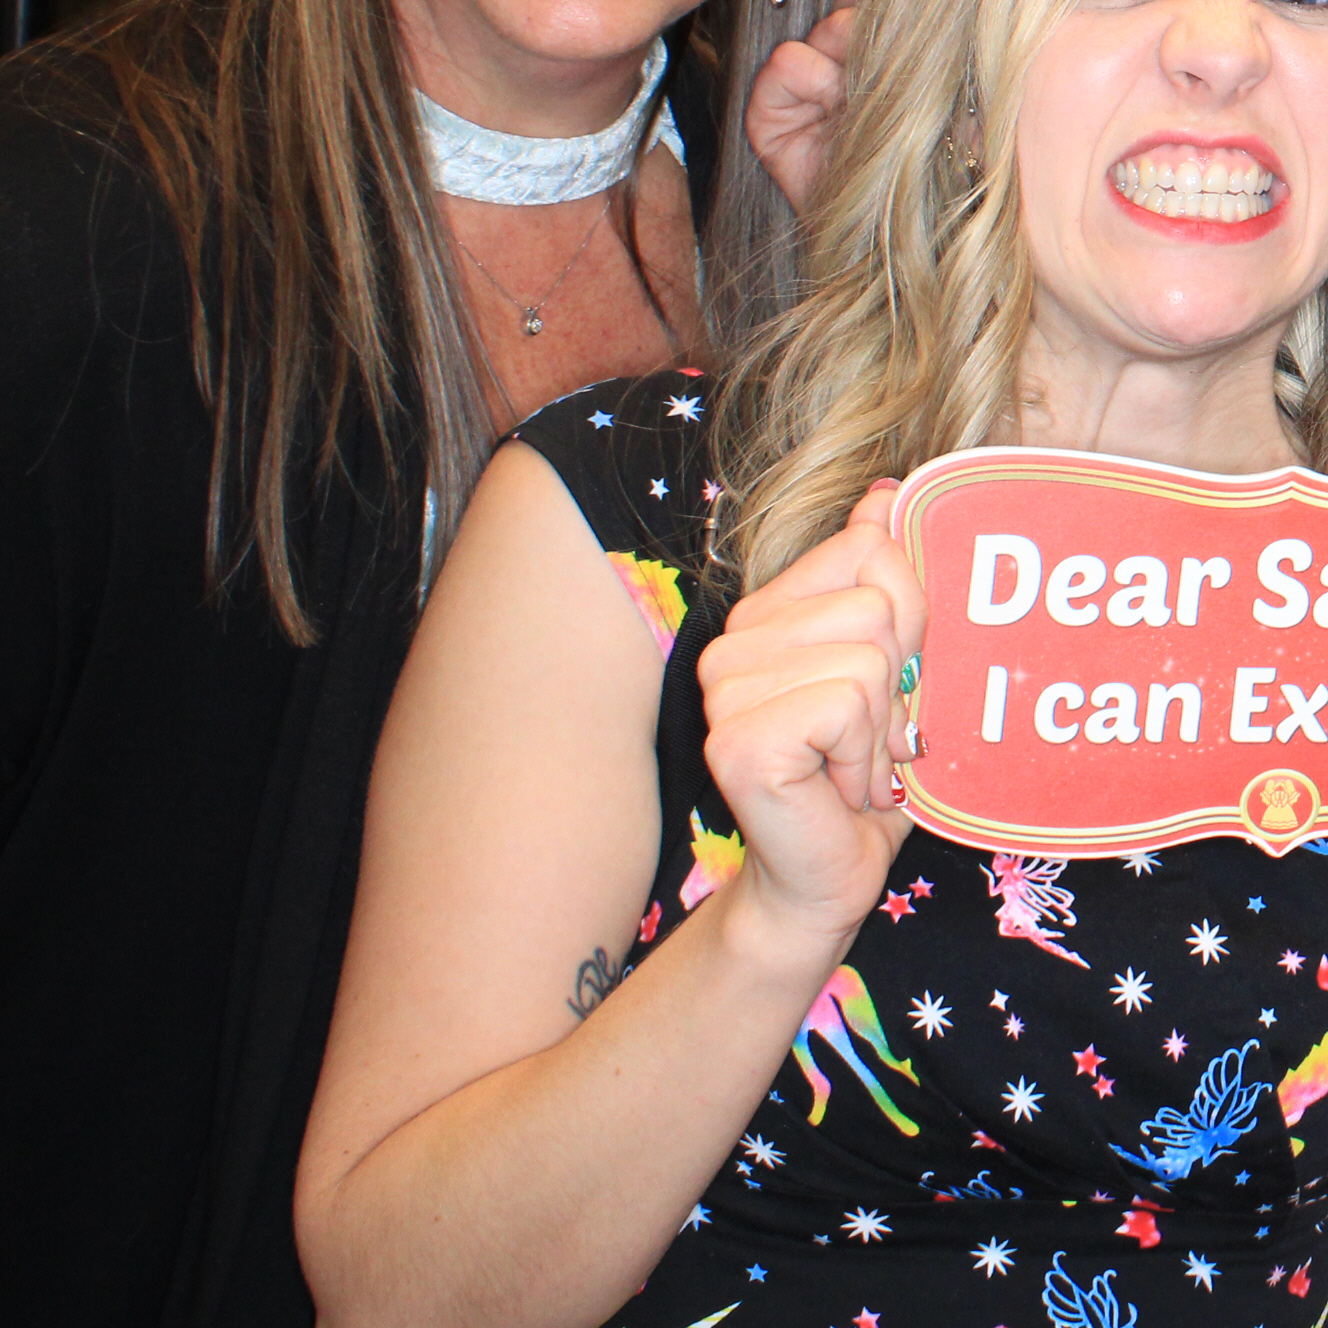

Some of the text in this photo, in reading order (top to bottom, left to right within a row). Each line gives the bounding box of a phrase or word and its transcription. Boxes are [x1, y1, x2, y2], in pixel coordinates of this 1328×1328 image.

[966, 533, 1232, 627] Dear
[980, 665, 1009, 744] I
[1033, 681, 1203, 744] can
